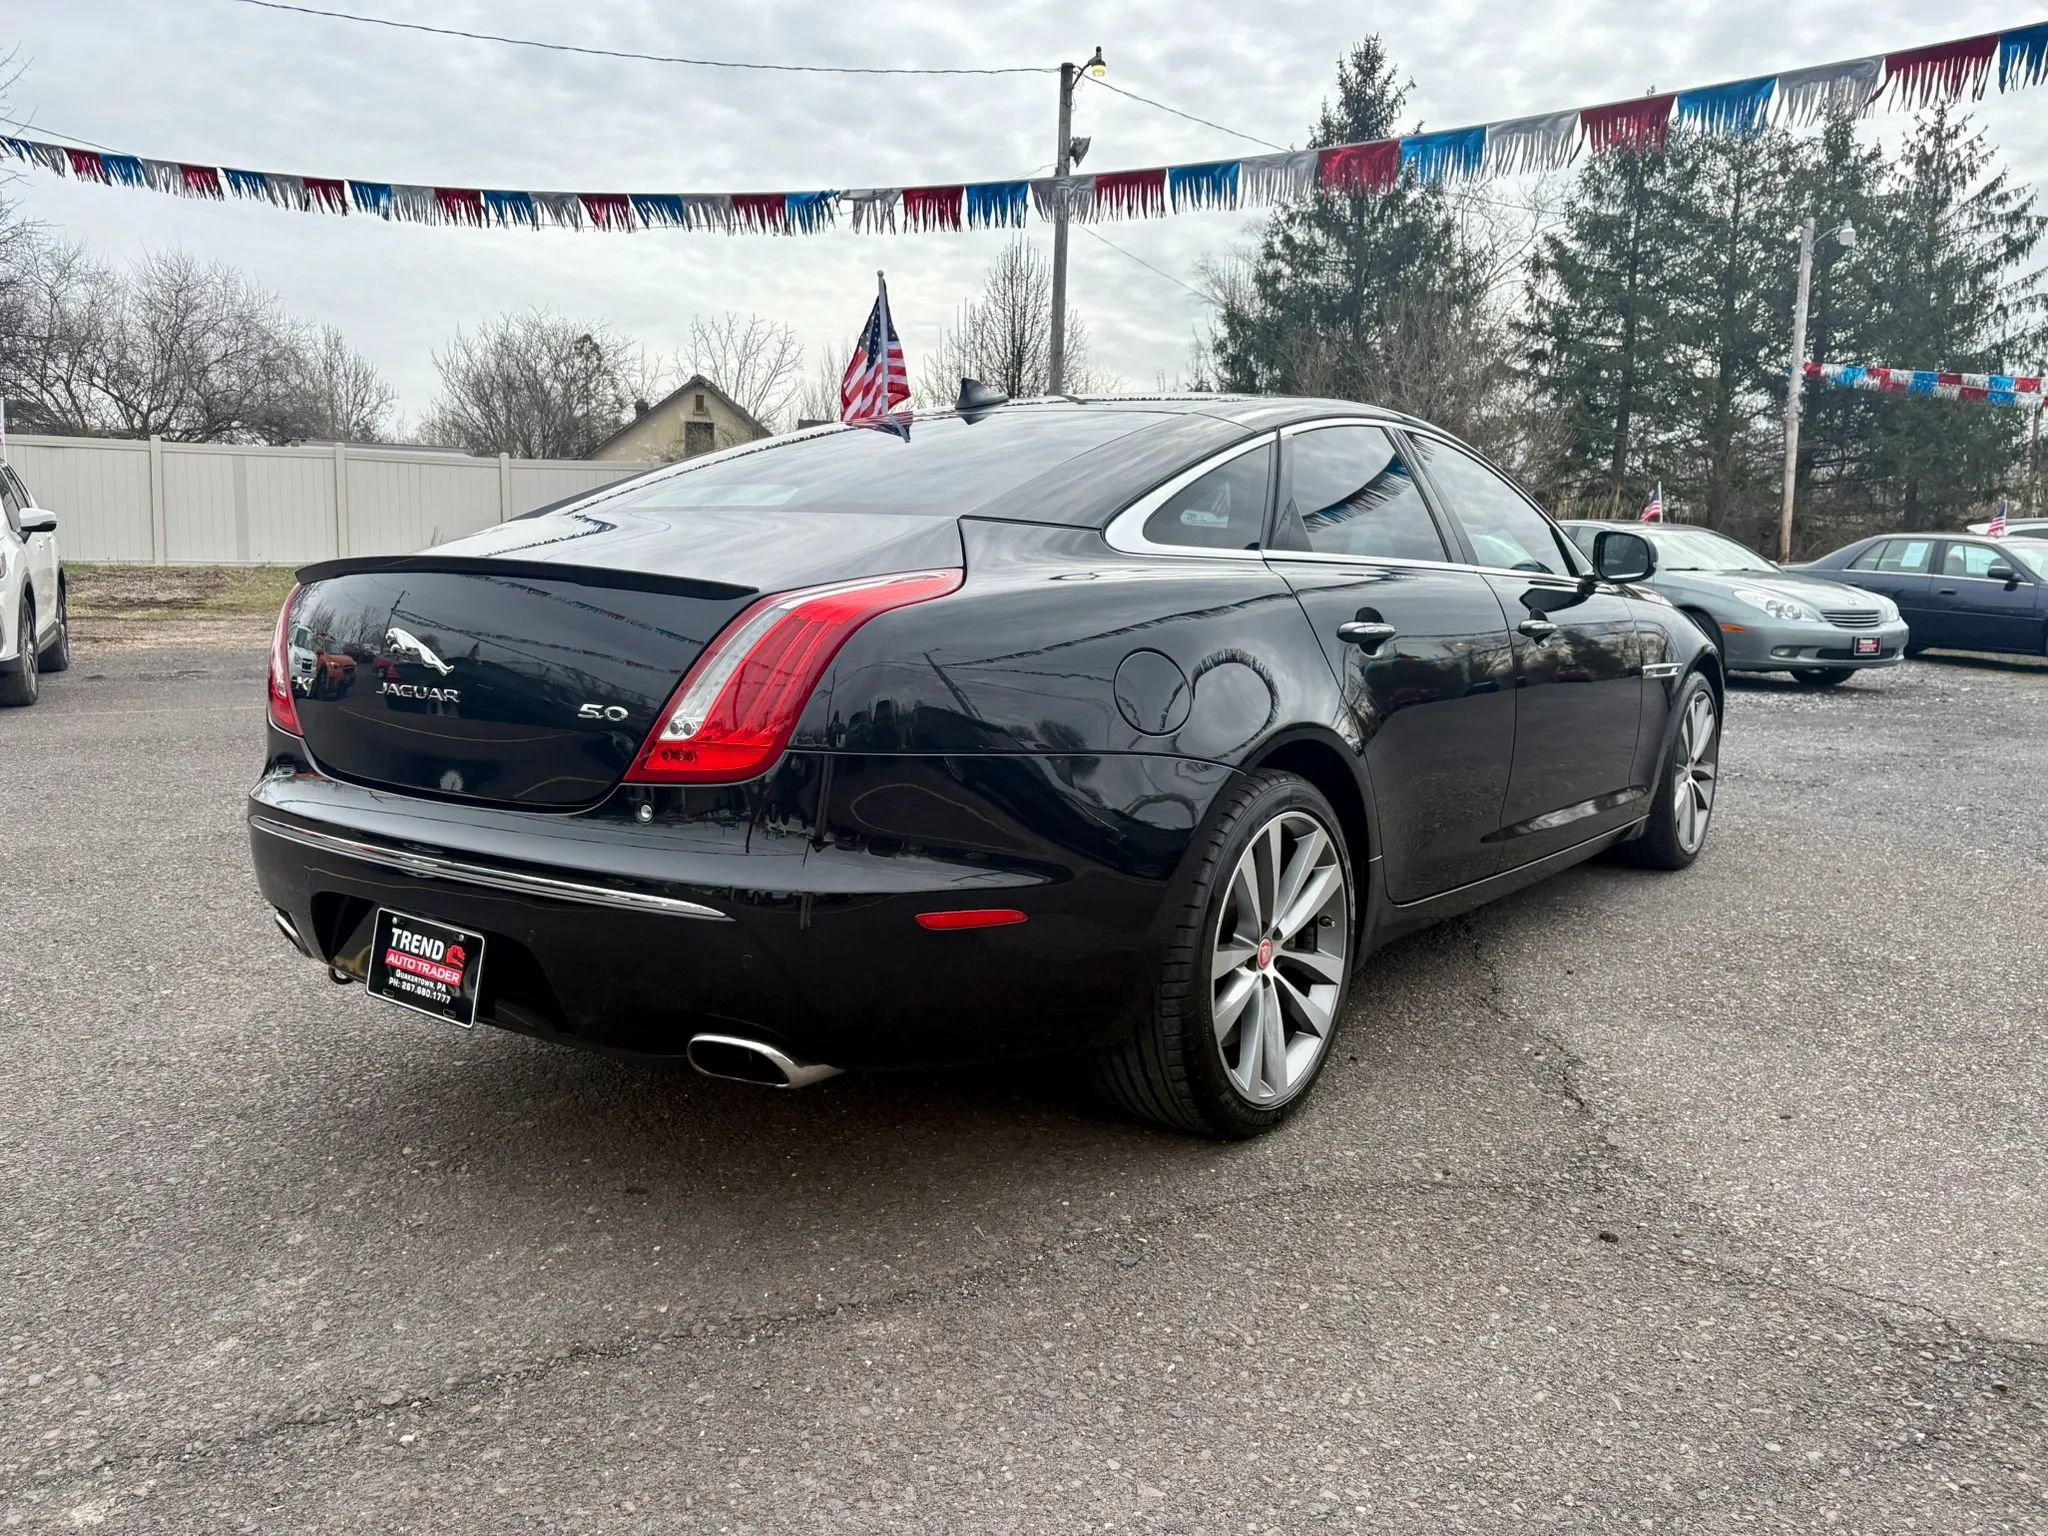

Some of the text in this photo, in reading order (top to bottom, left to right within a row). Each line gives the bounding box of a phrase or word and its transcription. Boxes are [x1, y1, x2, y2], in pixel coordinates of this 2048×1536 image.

[376, 682, 461, 702] JAGUAR
[391, 927, 445, 961] TREND
[388, 976, 400, 988] PH:
[436, 982, 447, 993] PA
